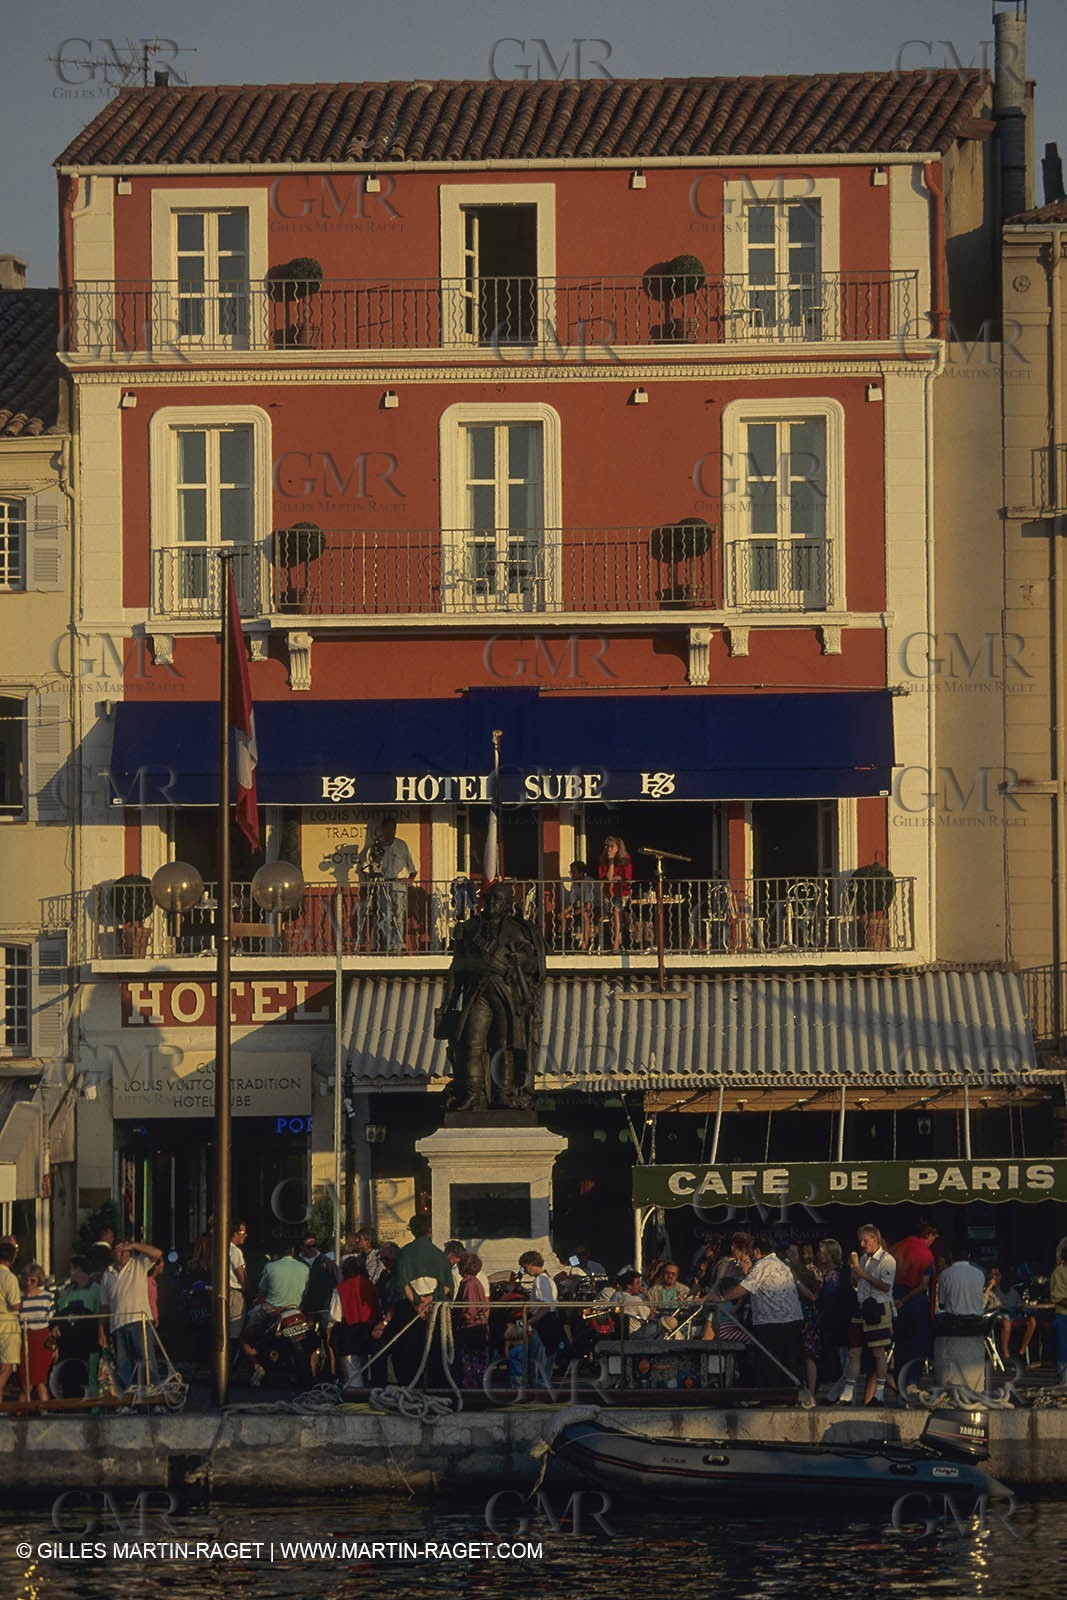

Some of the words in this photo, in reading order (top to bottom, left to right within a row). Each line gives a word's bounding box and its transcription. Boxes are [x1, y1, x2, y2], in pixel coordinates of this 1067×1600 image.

[524, 774, 602, 800] SUBE
[127, 981, 330, 1024] HOTEL
[196, 1063, 216, 1074] CLU
[167, 1079, 214, 1091] VUITTO
[230, 1095, 251, 1107] UBE
[829, 1171, 868, 1191] DE
[908, 1165, 1055, 1191] PARIS
